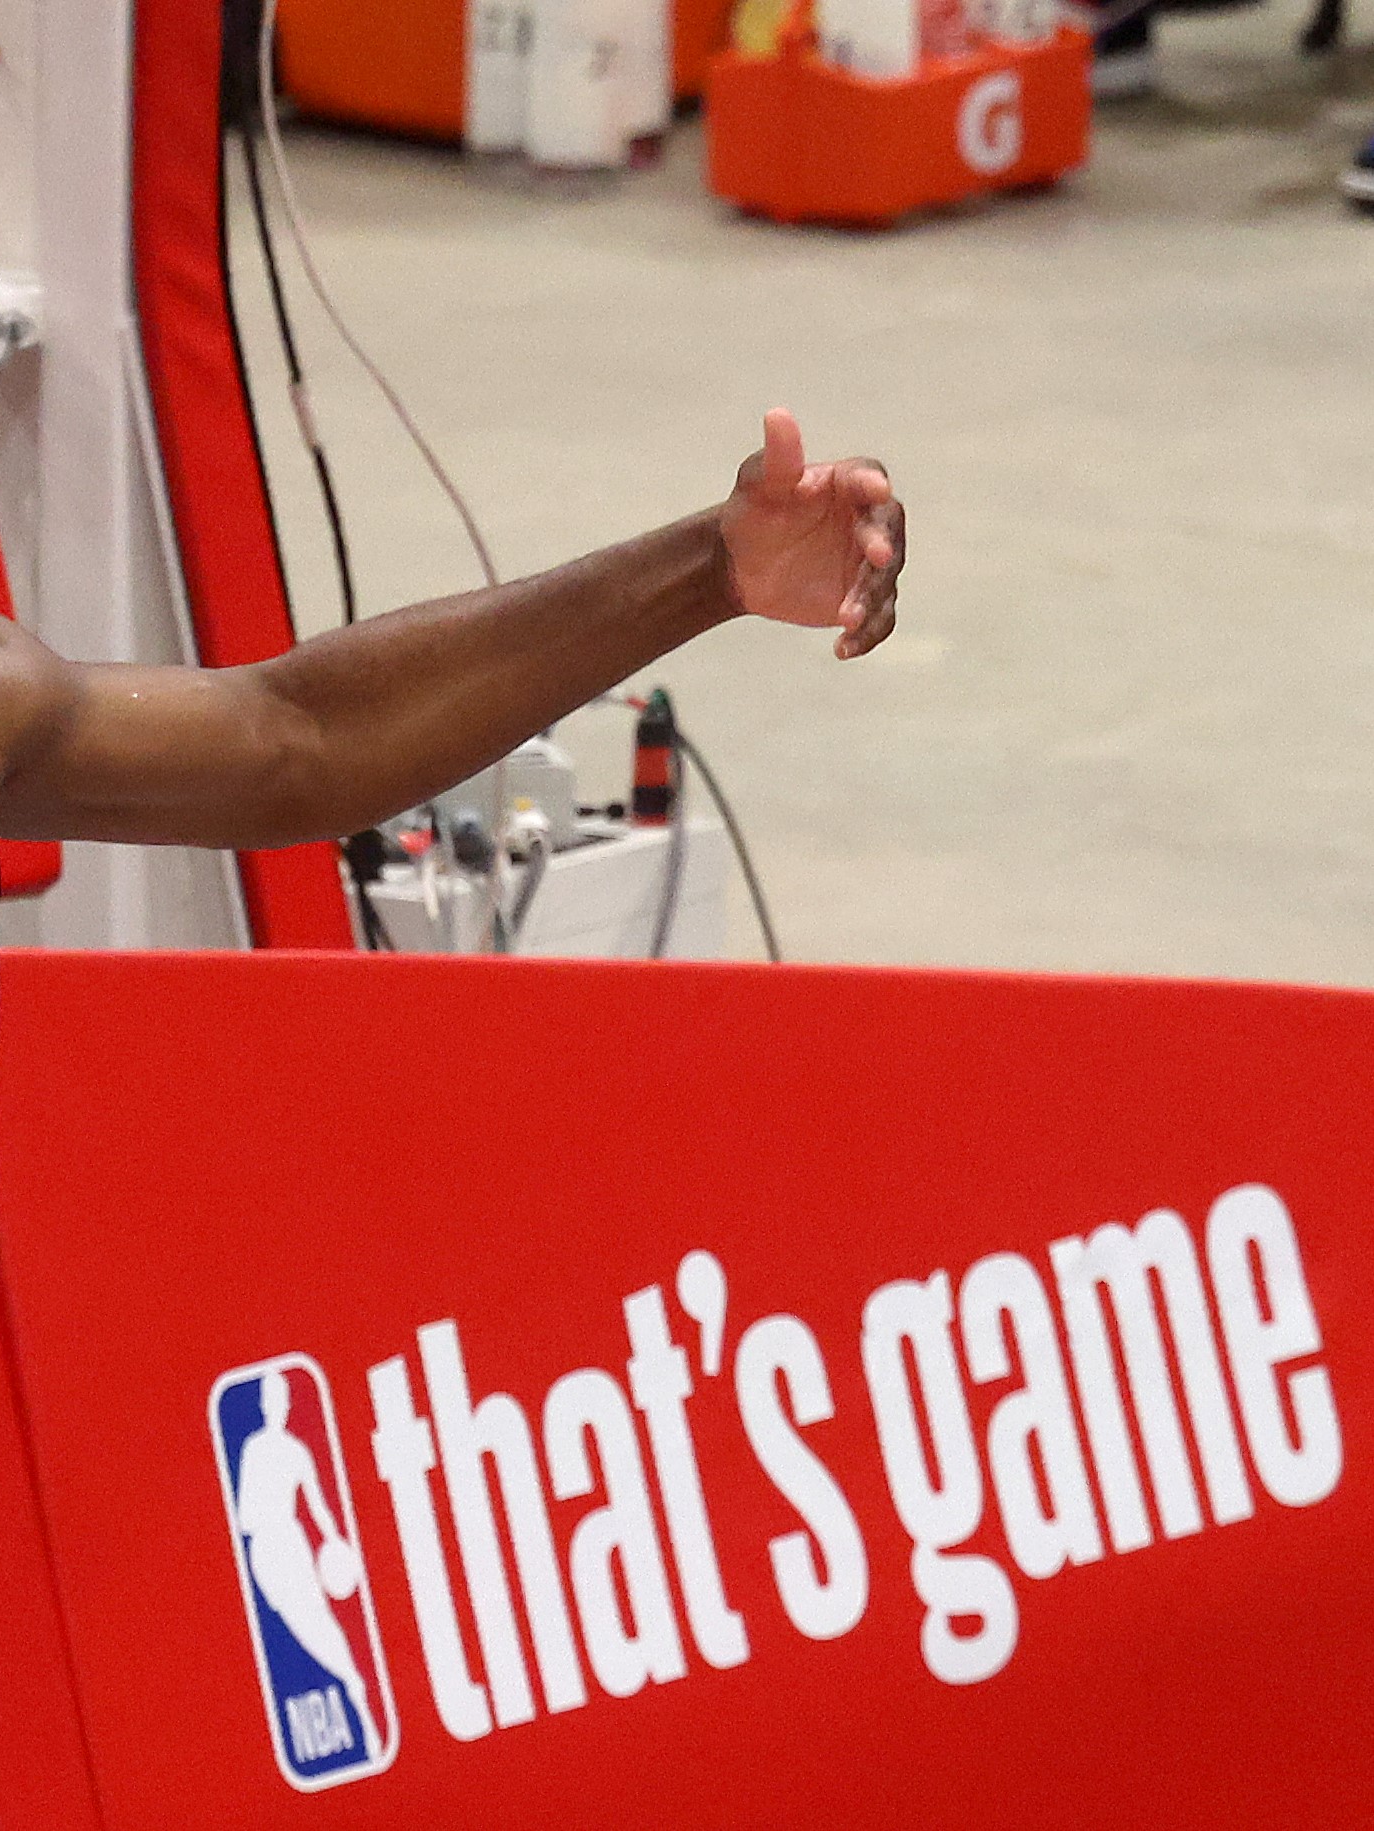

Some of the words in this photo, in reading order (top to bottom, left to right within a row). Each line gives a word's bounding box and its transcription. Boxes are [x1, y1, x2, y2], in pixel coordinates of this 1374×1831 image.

[958, 70, 1020, 175] G
[367, 1249, 871, 1743] that's
[861, 1183, 1345, 1686] game
[285, 1684, 354, 1764] NBA
